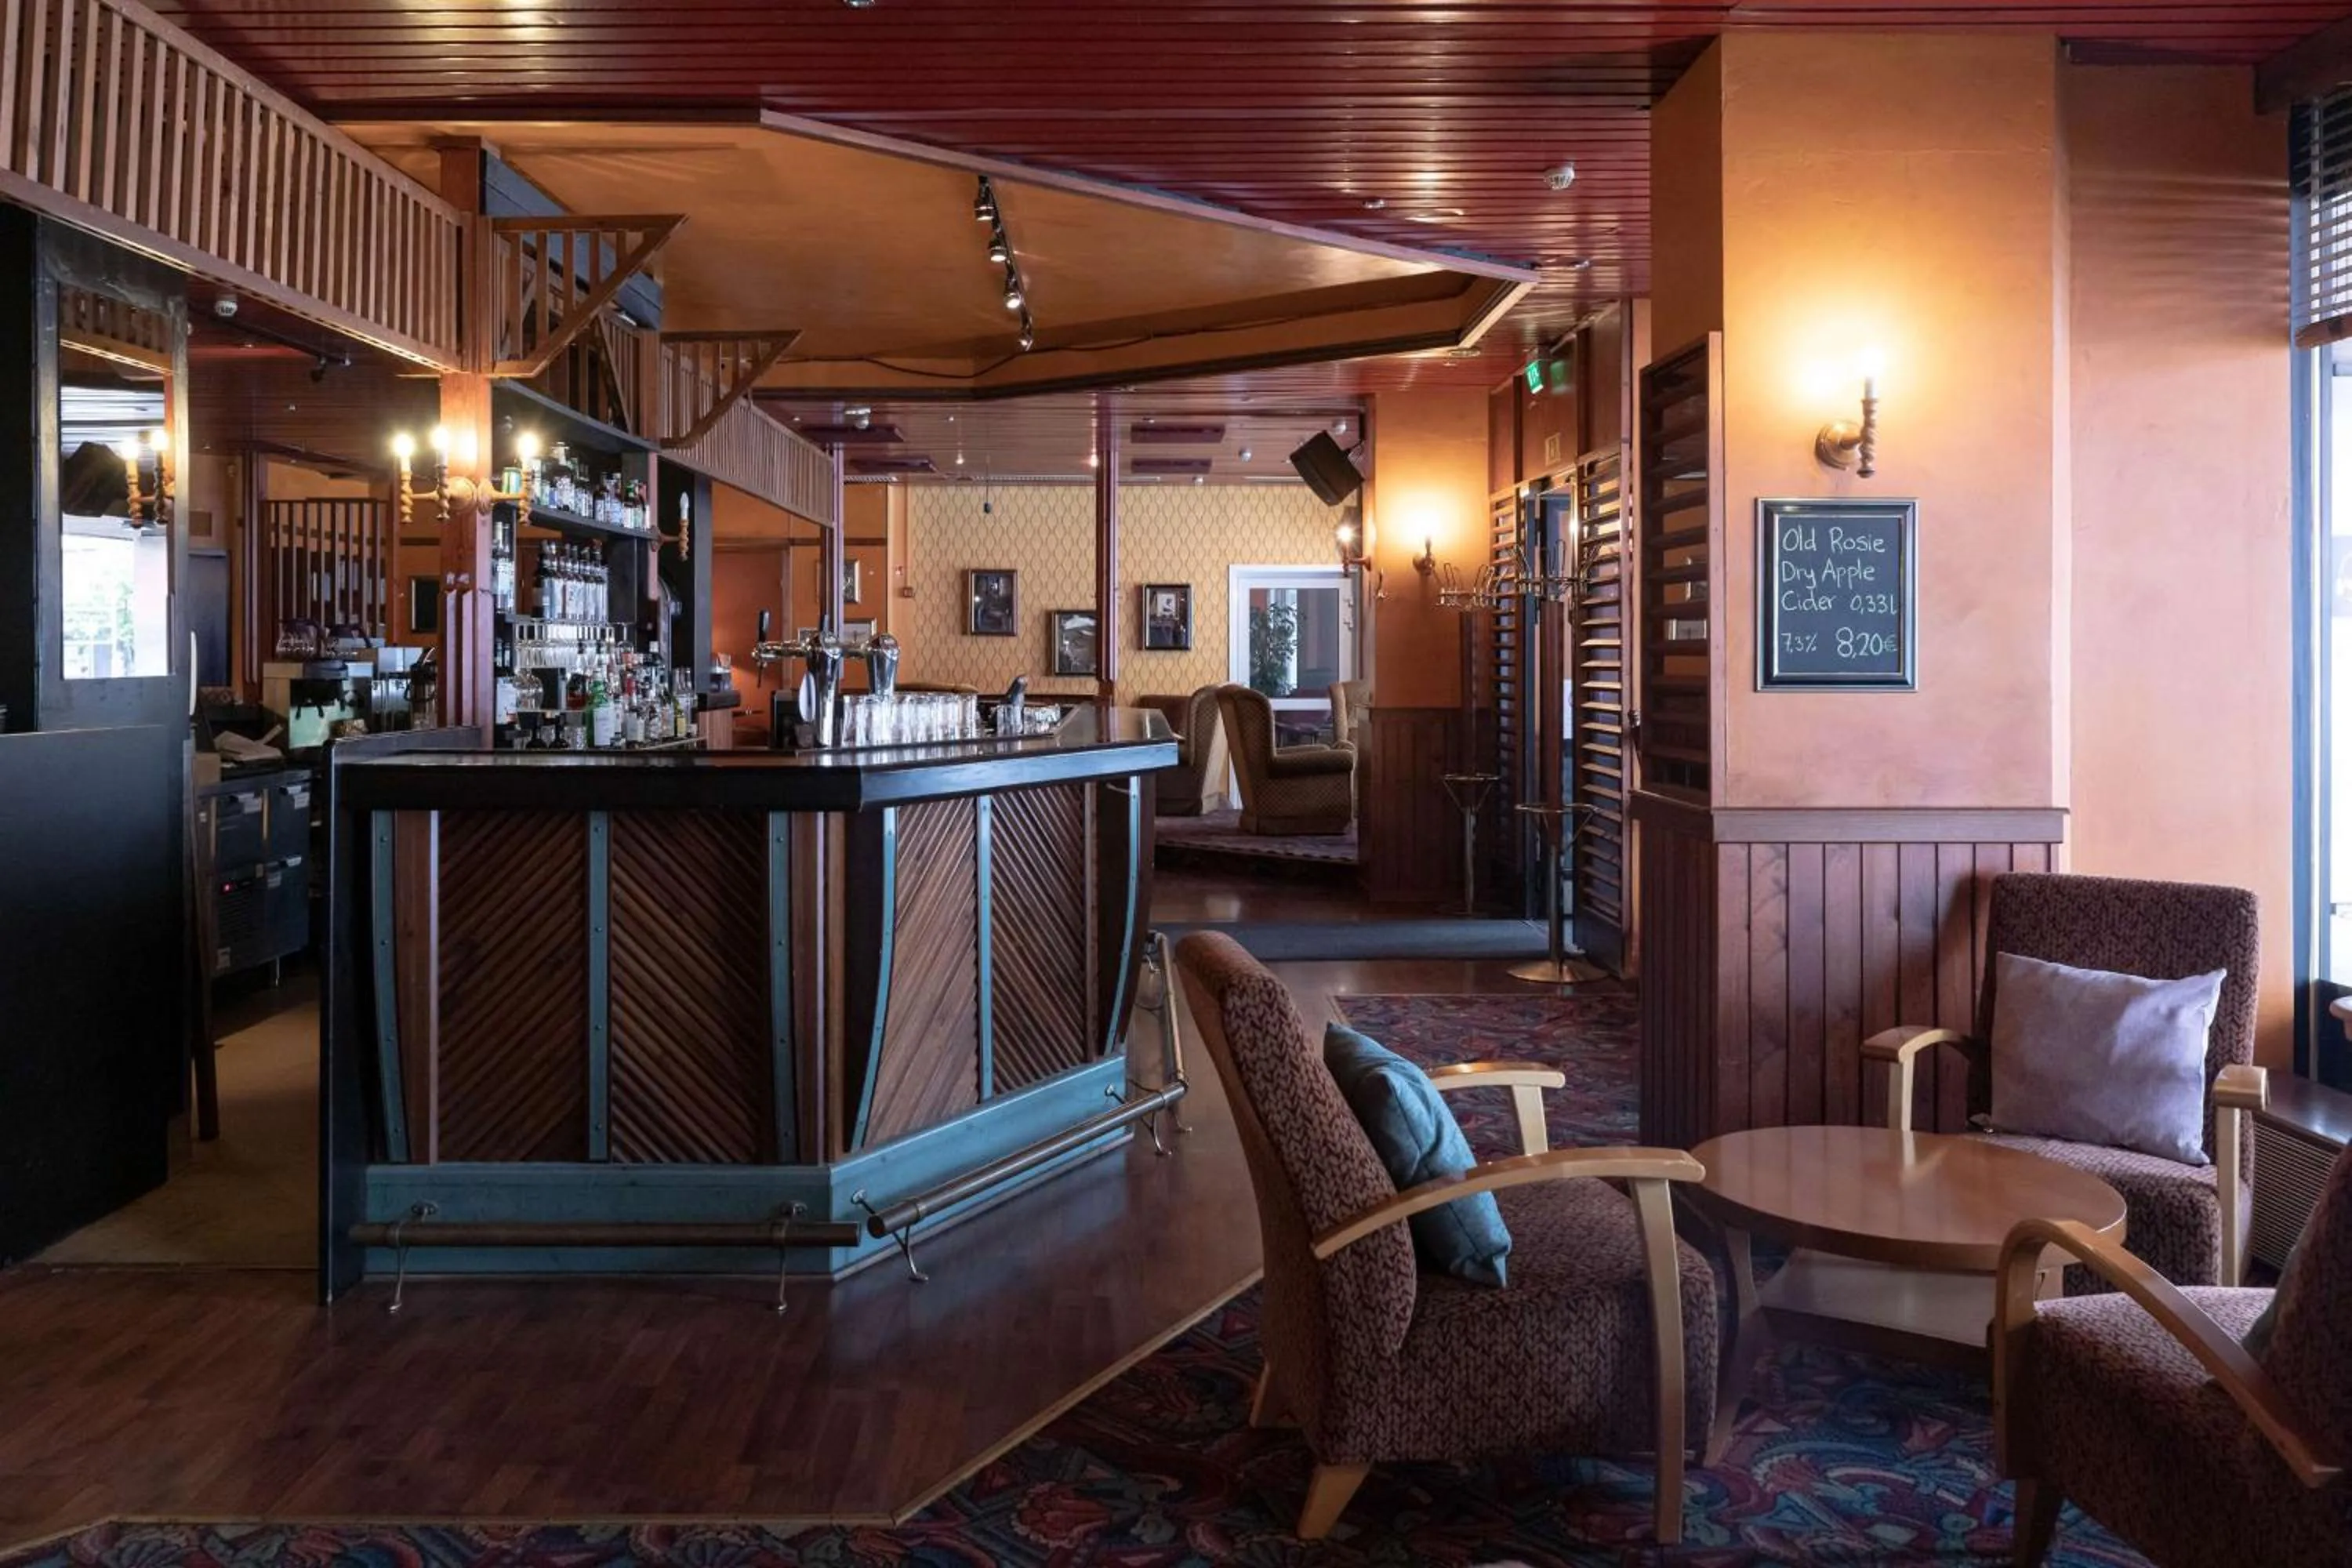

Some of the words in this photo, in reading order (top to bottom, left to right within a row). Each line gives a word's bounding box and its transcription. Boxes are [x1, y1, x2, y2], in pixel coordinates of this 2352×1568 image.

[1782, 524, 1817, 552] Old
[1828, 526, 1886, 554] Rosie
[1781, 561, 1817, 589] Dry
[1821, 557, 1875, 590] Apple
[1781, 590, 1835, 612] Cider
[1835, 626, 1898, 659] 8,20€
